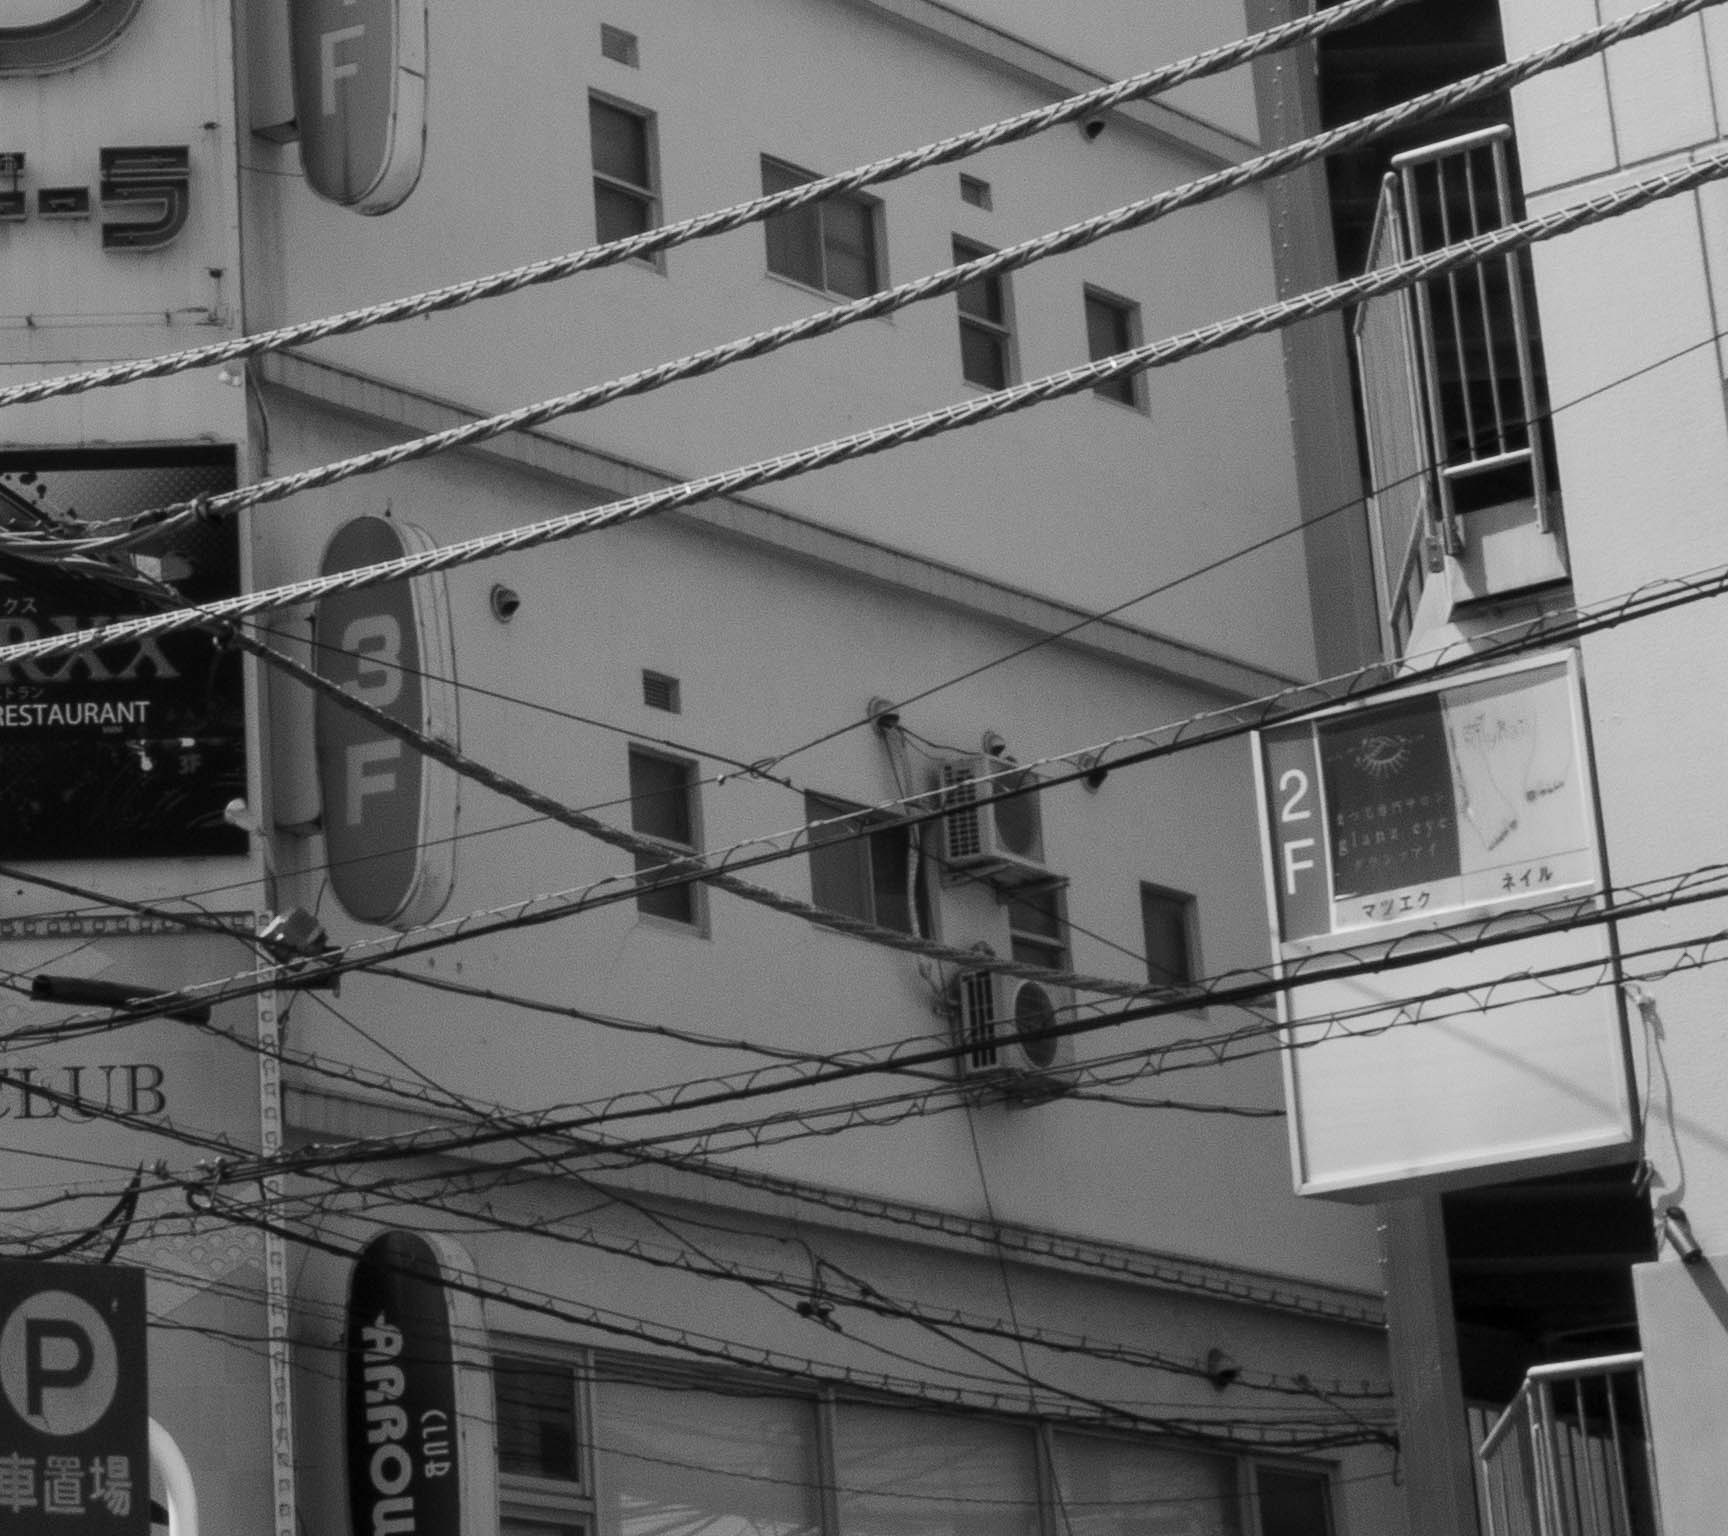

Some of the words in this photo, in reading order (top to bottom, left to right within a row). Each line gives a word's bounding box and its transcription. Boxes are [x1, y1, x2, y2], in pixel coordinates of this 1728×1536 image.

[1502, 867, 1553, 891] ネイル
[1362, 892, 1431, 917] マツエク
[421, 1409, 452, 1478] CLUB
